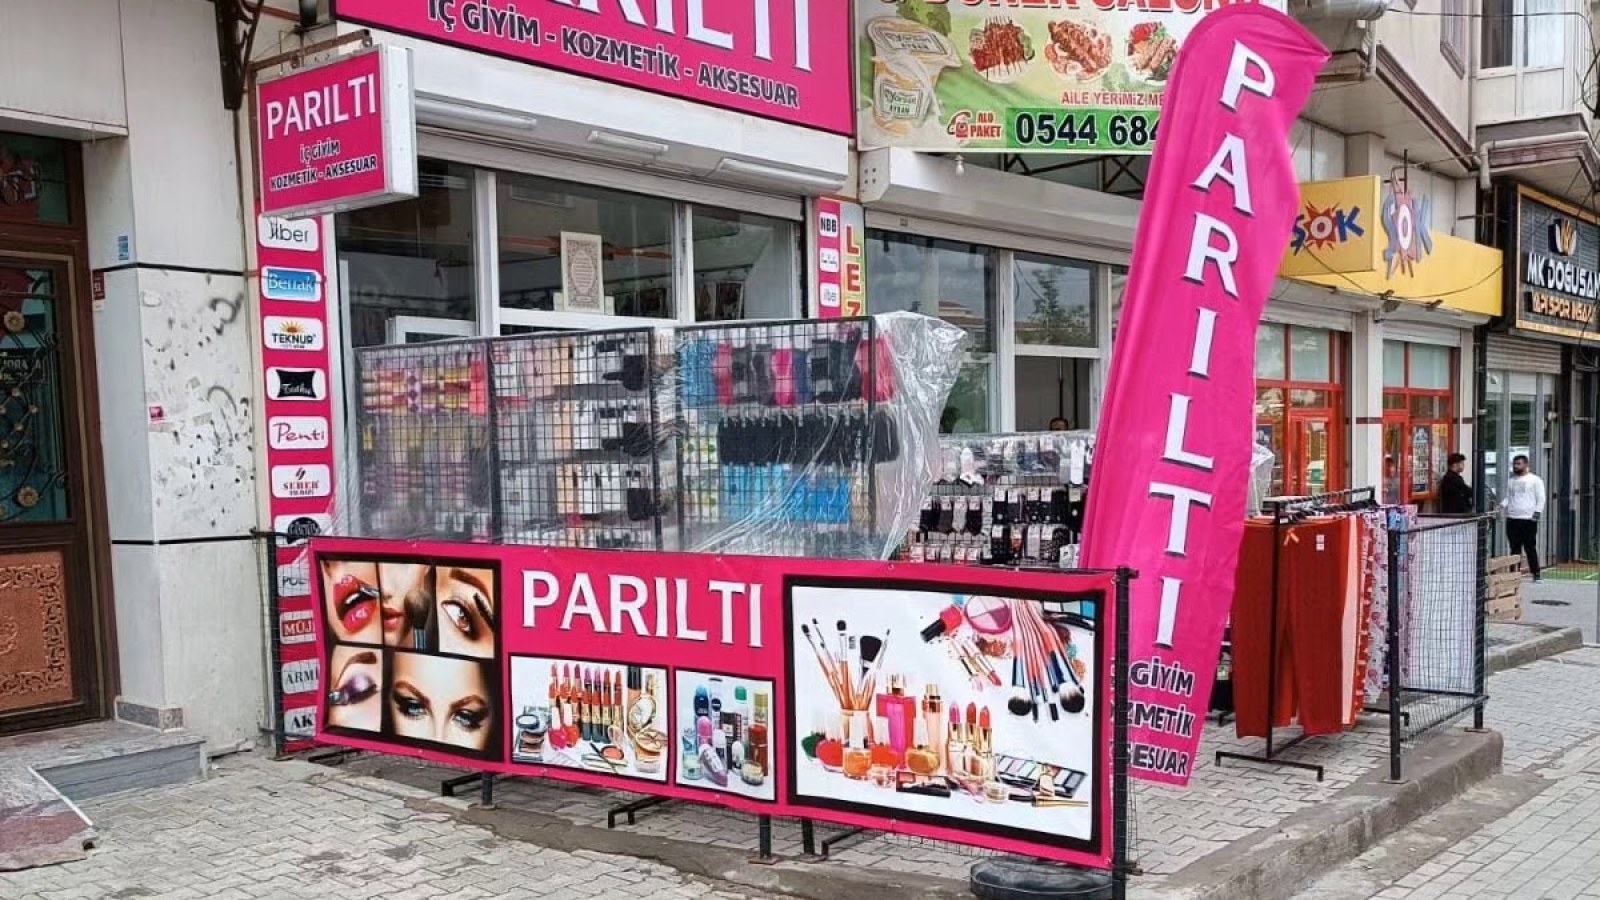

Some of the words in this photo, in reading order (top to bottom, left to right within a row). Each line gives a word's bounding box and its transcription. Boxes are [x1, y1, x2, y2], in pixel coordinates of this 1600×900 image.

[462, 4, 540, 45] GİYİM
[546, 34, 556, 43] -
[561, 26, 680, 79] KOZMETİK
[684, 67, 694, 77] -
[697, 62, 800, 108] AKSESUAR
[266, 73, 376, 140] PARILTI
[970, 126, 1001, 138] PAKET
[1015, 113, 1098, 144] 0544
[312, 137, 340, 161] GİYİM
[270, 164, 317, 192] KOZMETİK
[324, 154, 377, 180] AKSESUAR
[821, 217, 837, 233] NBB
[272, 333, 313, 344] TEKNUR
[1148, 39, 1277, 650] PARILTI
[273, 422, 325, 443] Penti
[521, 570, 764, 648] PARILTI
[1130, 656, 1195, 697] GİYİM
